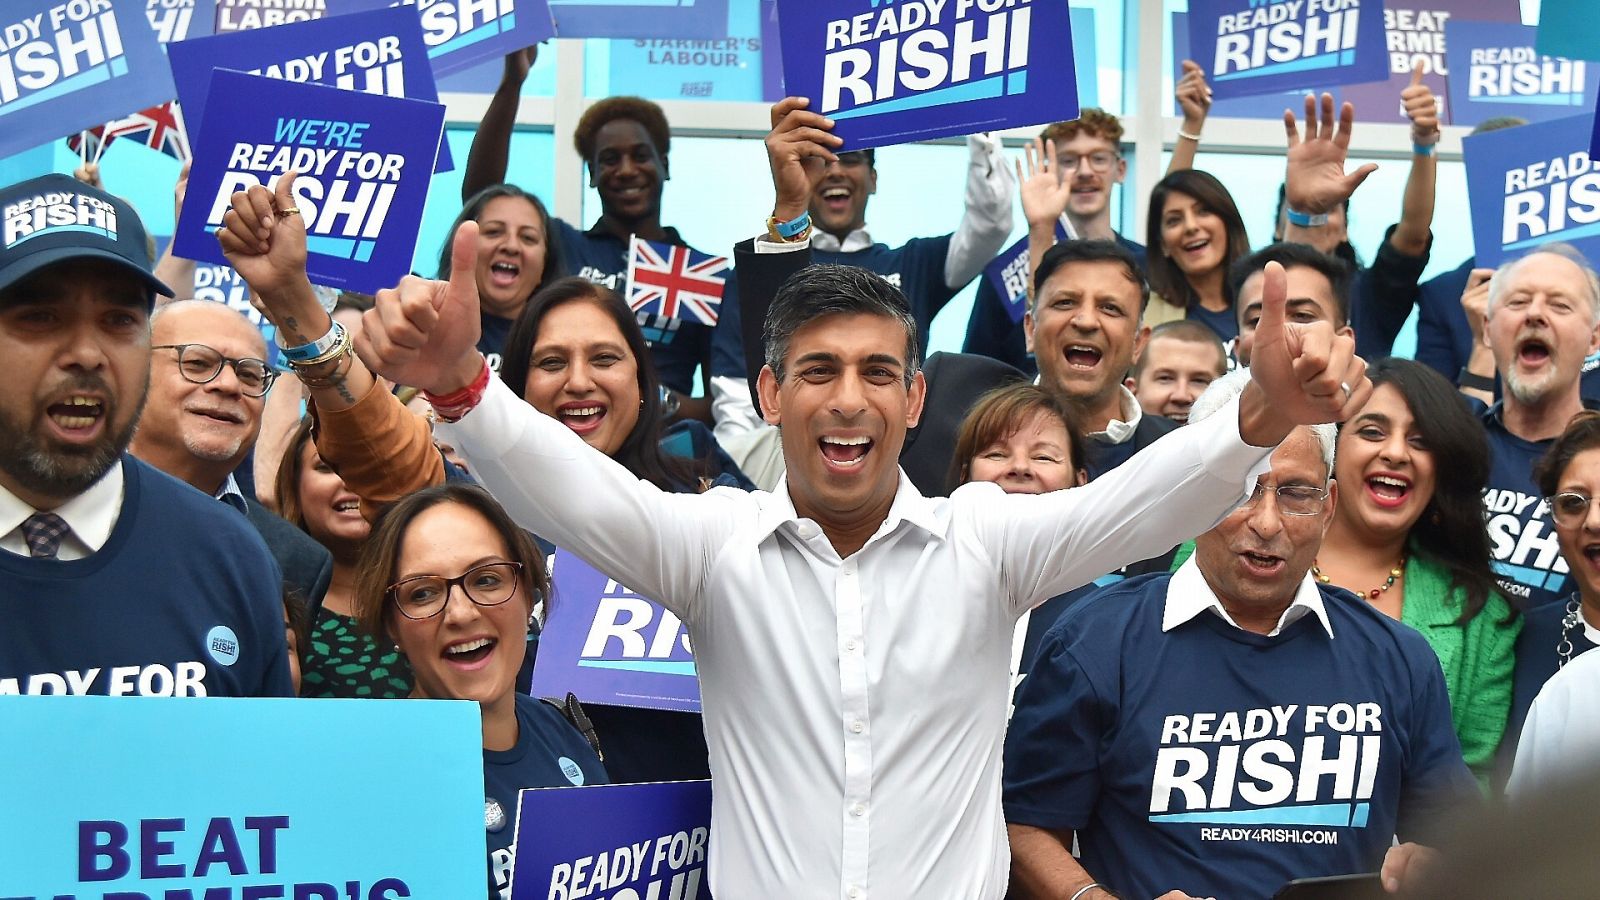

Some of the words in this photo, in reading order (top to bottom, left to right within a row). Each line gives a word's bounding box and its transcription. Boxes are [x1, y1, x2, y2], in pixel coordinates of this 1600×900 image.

[825, 0, 945, 50] READY
[1218, 1, 1302, 36] READY
[0, 10, 124, 105] ISHI
[334, 36, 402, 74] FOR
[820, 6, 1032, 114] RISHI
[1213, 9, 1361, 77] RISHI
[1468, 60, 1586, 97] RISHI
[273, 117, 370, 149] WE'RE
[227, 142, 337, 177] READY
[335, 150, 405, 181] FOR
[1504, 151, 1600, 195] READ
[4, 192, 76, 221] READY
[77, 193, 117, 215] FOR
[4, 203, 118, 247] RISHI
[206, 170, 398, 239] RSHI
[108, 661, 208, 697] FOR
[1160, 704, 1299, 744] READY
[1304, 702, 1382, 733] FOR
[1149, 734, 1382, 813] RISHI
[77, 815, 290, 883] BEAT
[1200, 827, 1339, 845] READY4RISHI.COM
[547, 839, 652, 900] READY
[650, 826, 708, 877] FOR
